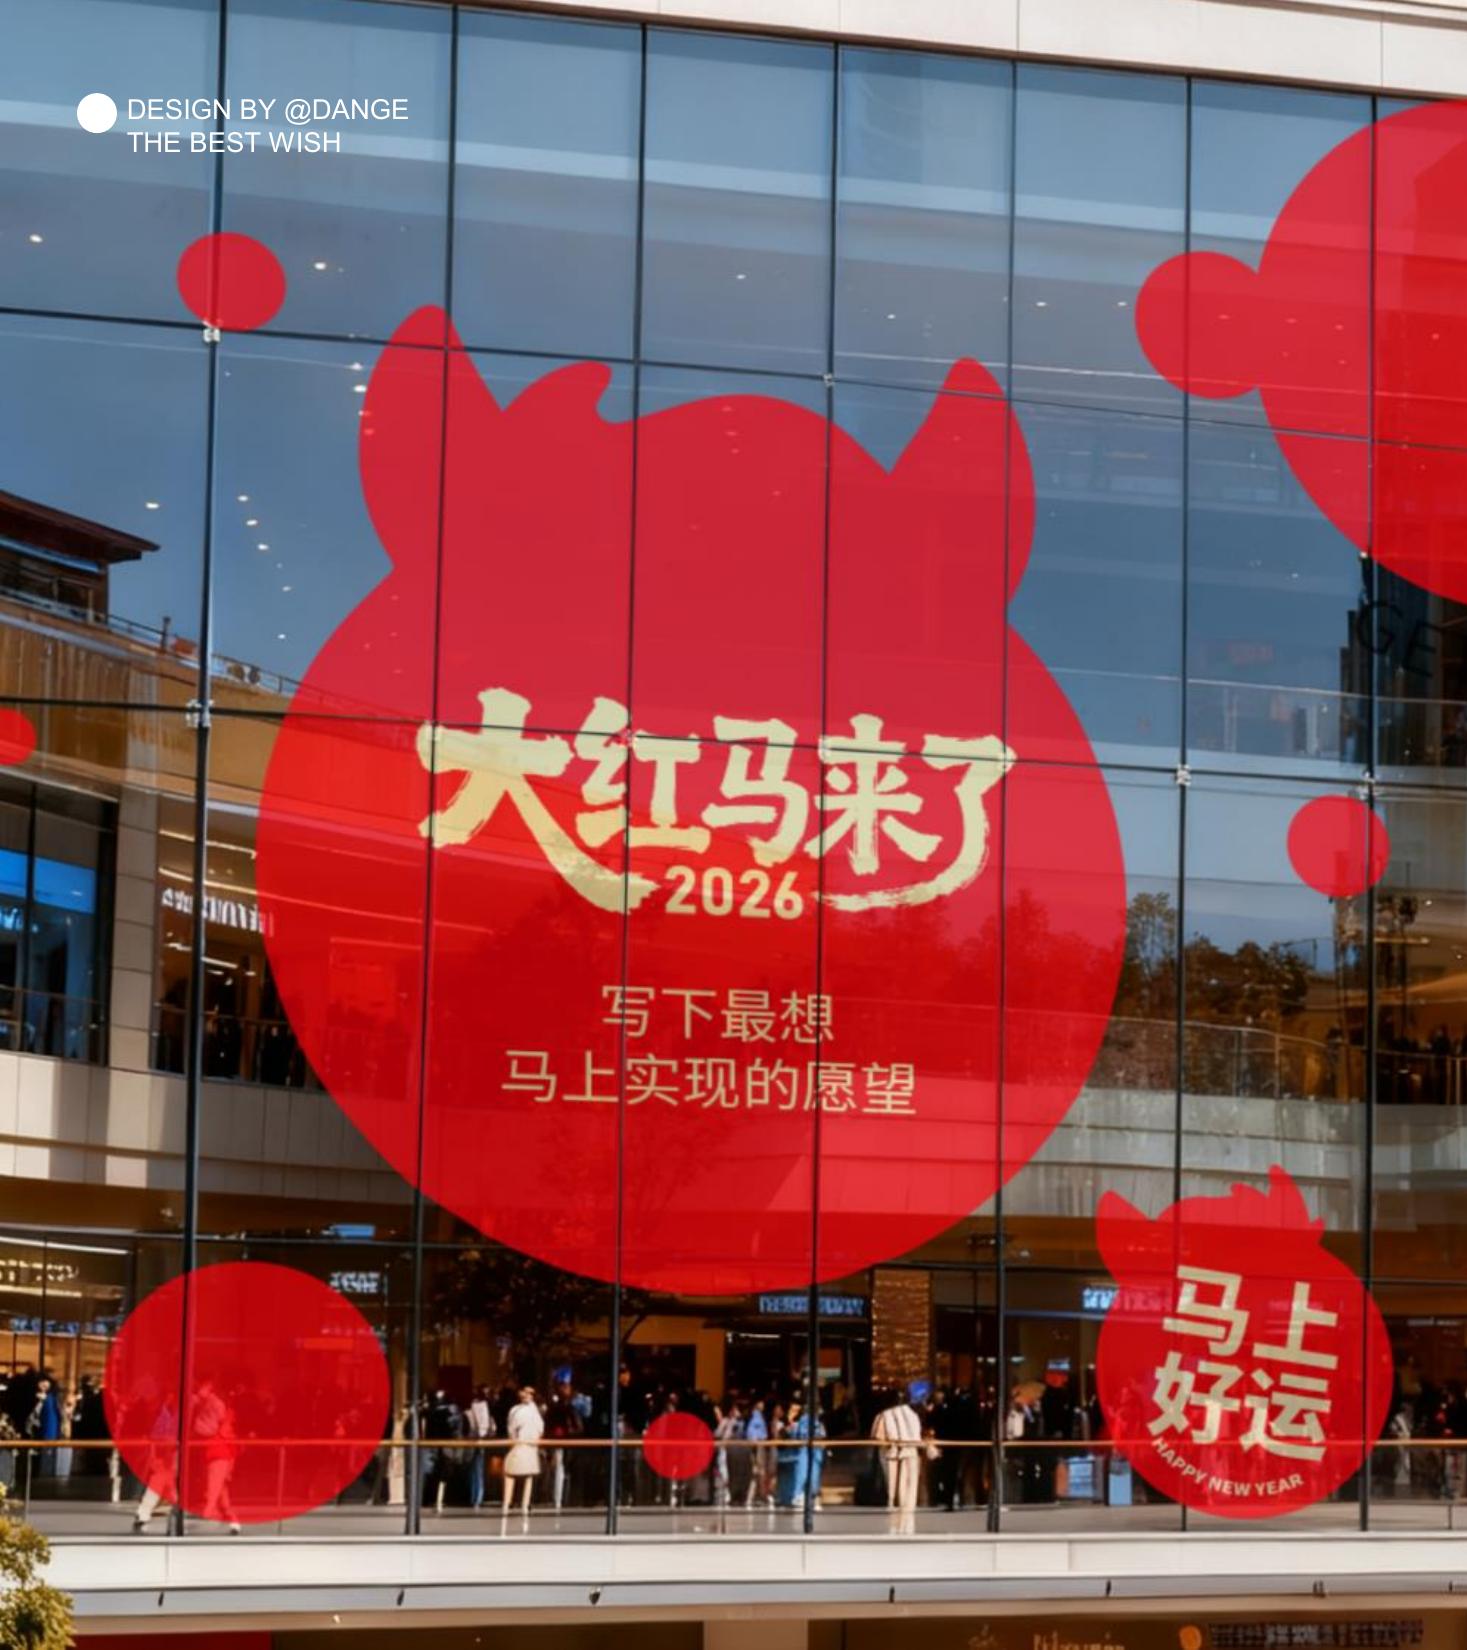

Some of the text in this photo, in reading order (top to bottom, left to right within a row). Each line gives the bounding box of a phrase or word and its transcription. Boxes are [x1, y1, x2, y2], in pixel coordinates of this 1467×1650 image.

[416, 687, 1017, 915] 大红马来了
[664, 865, 804, 920] 2026
[601, 984, 835, 1044] 写下最想
[501, 1049, 917, 1116] 马上实现的愿望
[1162, 1264, 1339, 1370] 马上
[1146, 1350, 1332, 1463] 好运
[1151, 1436, 1304, 1497] HAPPY NEW YEAR
